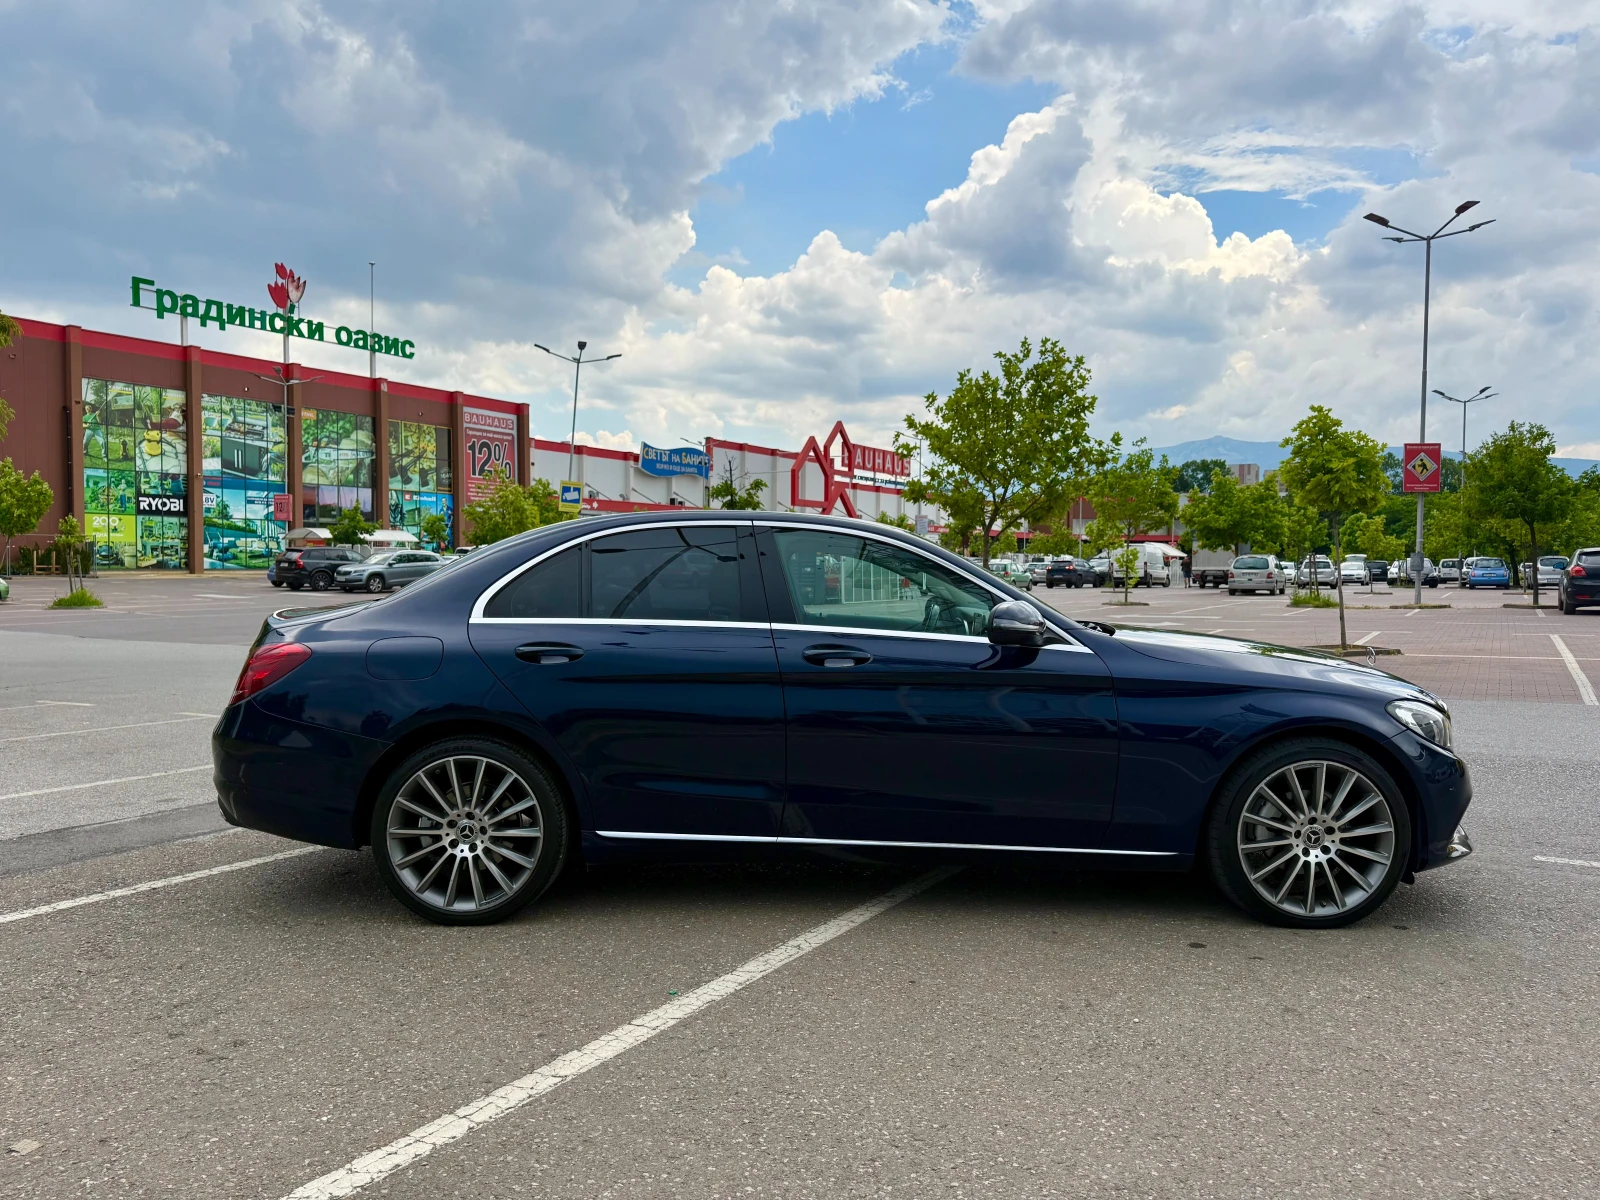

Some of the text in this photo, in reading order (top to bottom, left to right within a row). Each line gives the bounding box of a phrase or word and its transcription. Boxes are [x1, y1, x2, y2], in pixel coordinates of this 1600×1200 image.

[131, 276, 415, 360] Градински оазис
[464, 413, 514, 429] BAUHAUS
[466, 438, 512, 480] 12%
[643, 447, 670, 462] СВЕТЪТ
[139, 496, 184, 512] RYOBI
